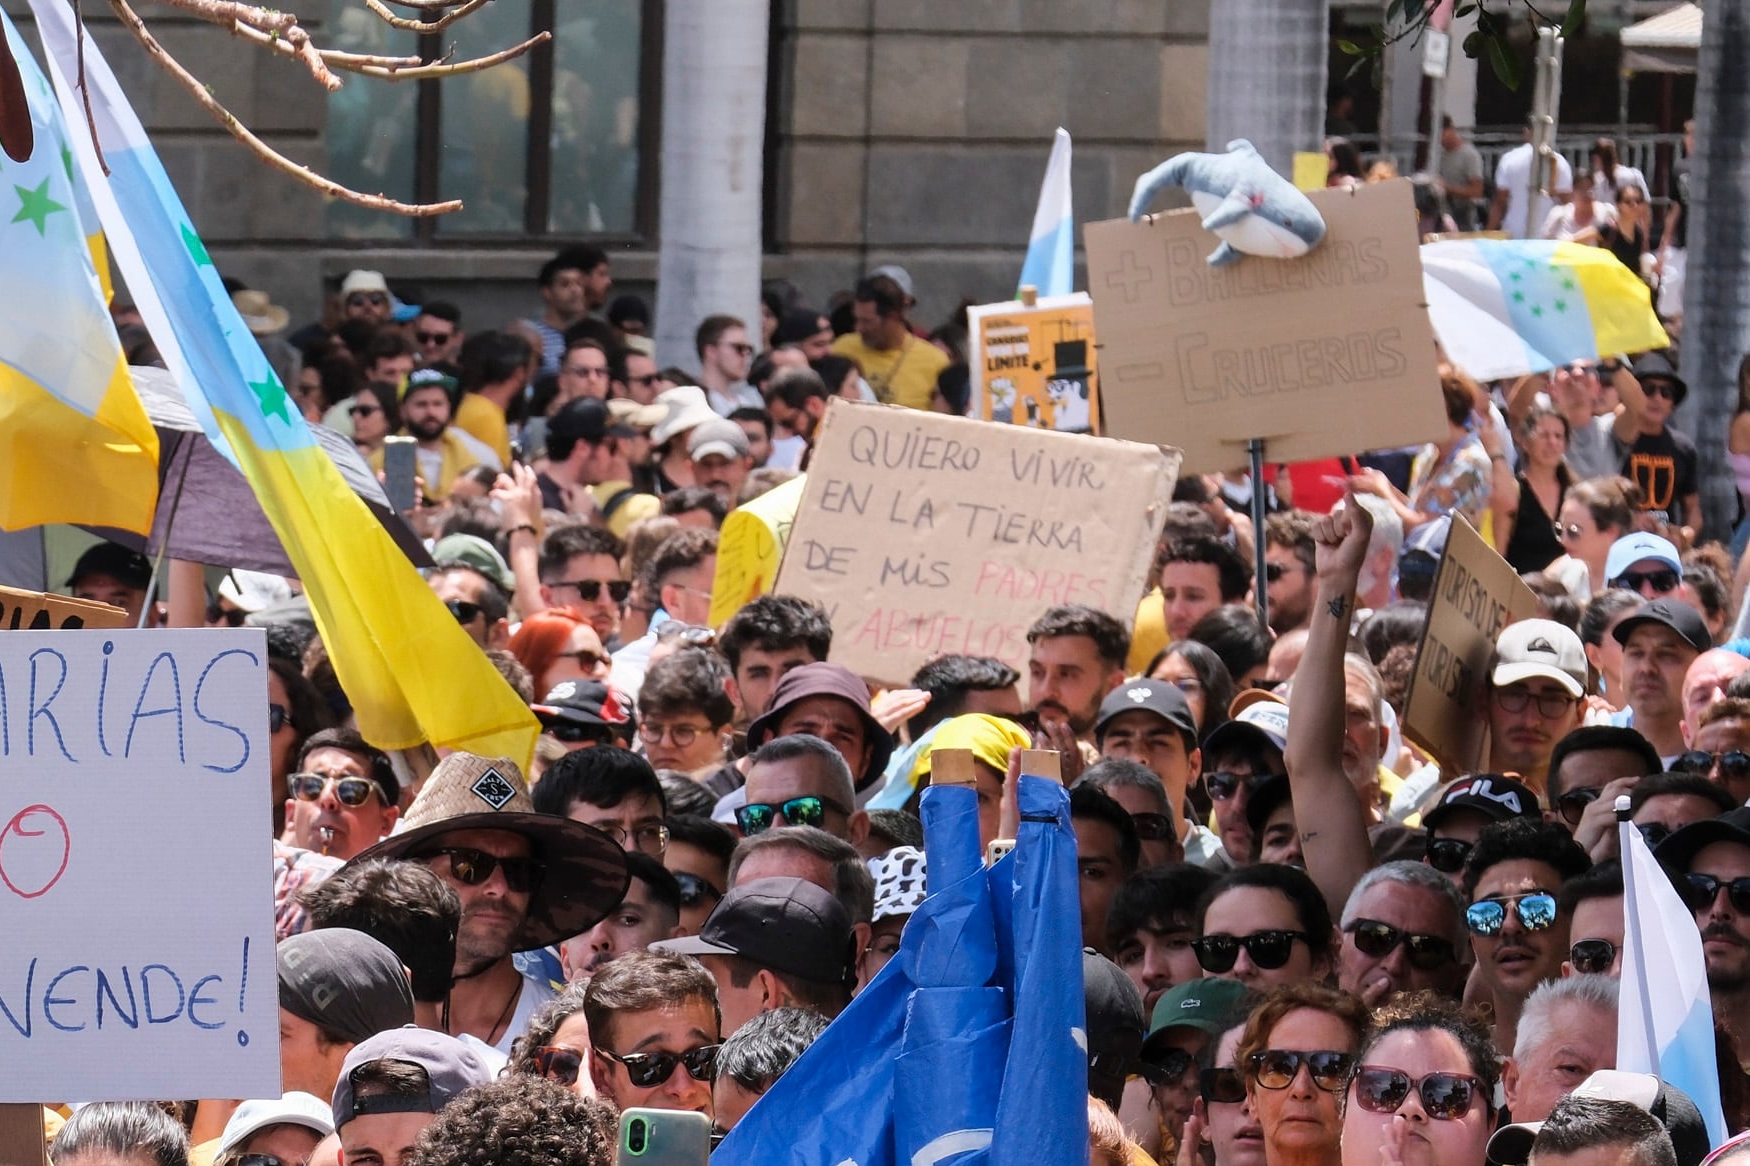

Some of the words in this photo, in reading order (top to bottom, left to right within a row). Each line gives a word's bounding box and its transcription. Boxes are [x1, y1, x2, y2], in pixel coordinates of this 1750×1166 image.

[1173, 326, 1408, 405] CRUCEROS
[820, 480, 873, 515] EN
[890, 490, 934, 528] LA
[805, 540, 857, 576] DE
[974, 561, 1106, 608] PADRES
[854, 607, 1026, 665] ABUELOS
[1445, 779, 1523, 813] FILA
